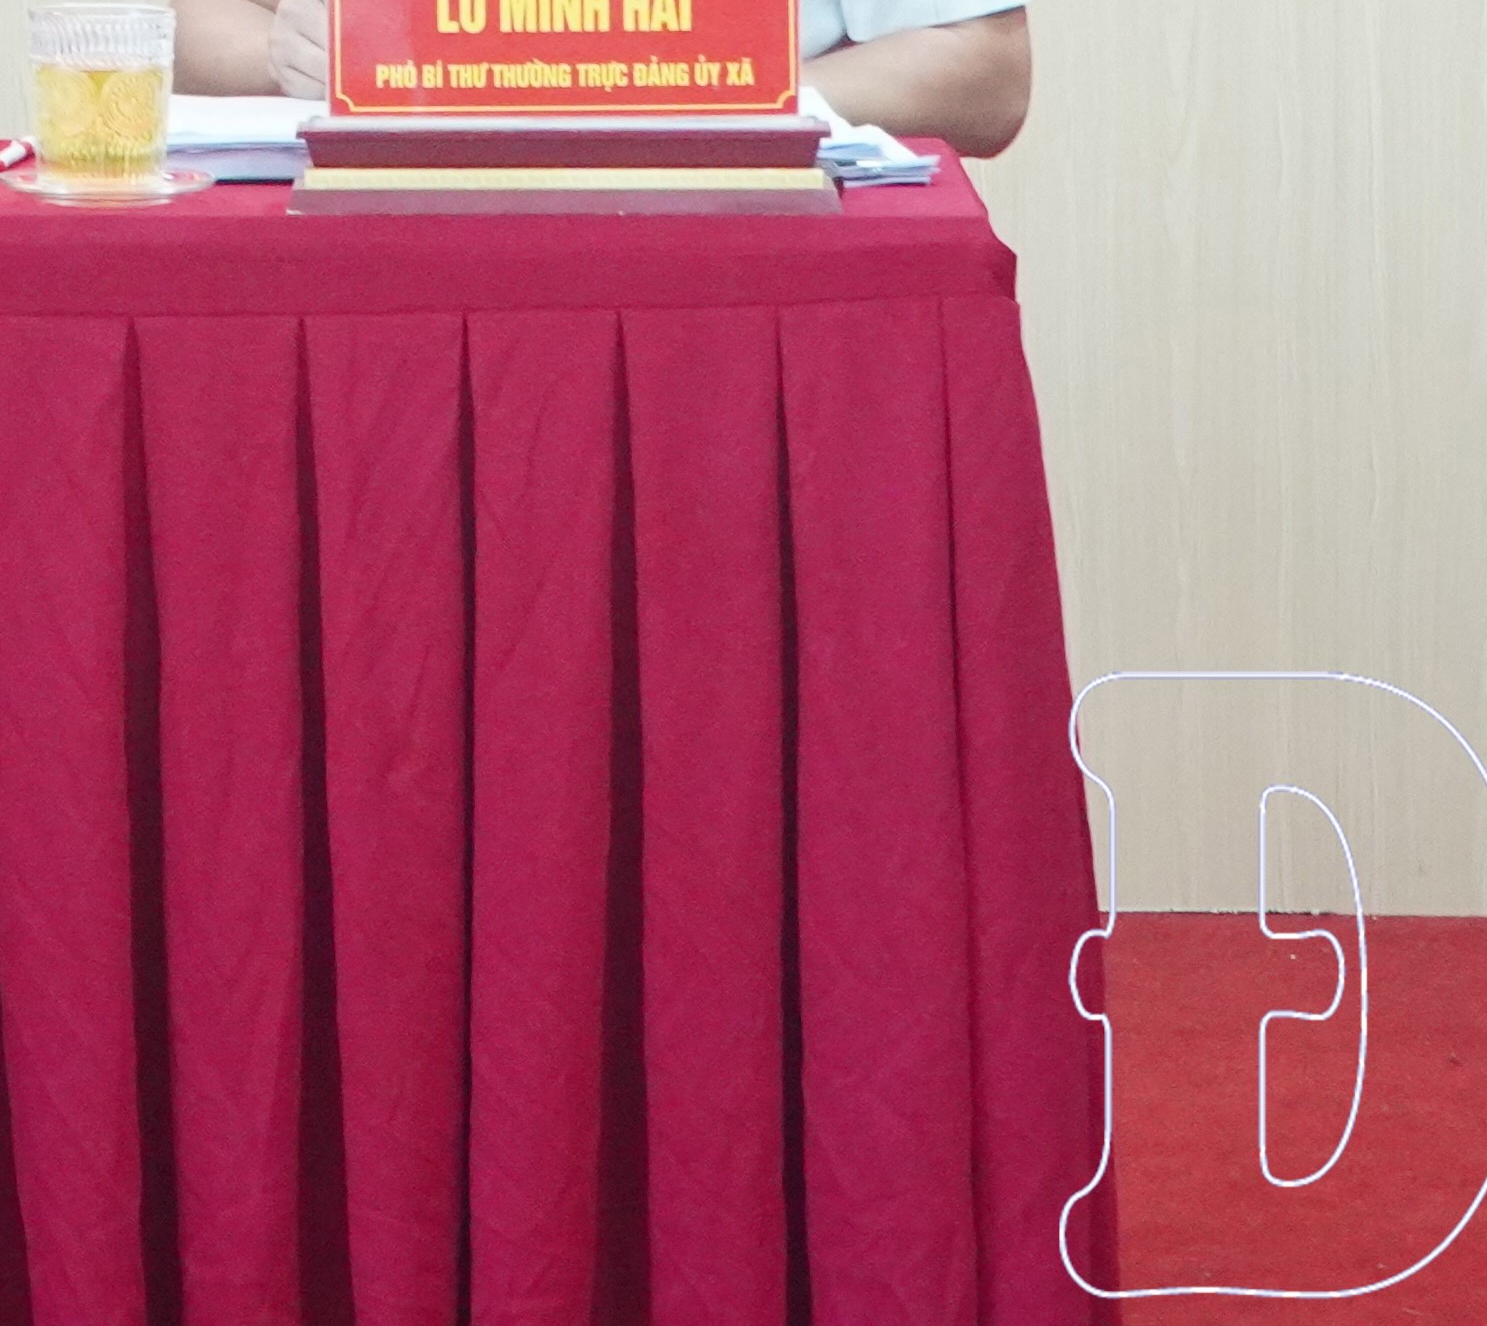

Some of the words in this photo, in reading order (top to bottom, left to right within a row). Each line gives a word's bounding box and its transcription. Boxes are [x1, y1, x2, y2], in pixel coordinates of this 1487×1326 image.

[375, 60, 419, 89] PHÓ
[421, 60, 444, 89] BÍ
[447, 61, 490, 89] THƯ
[490, 58, 573, 89] THƯỜNG
[575, 61, 629, 93] TRỰC
[632, 55, 691, 87] ĐẢNG
[693, 53, 722, 87] ỦY
[725, 57, 755, 86] XÃ
